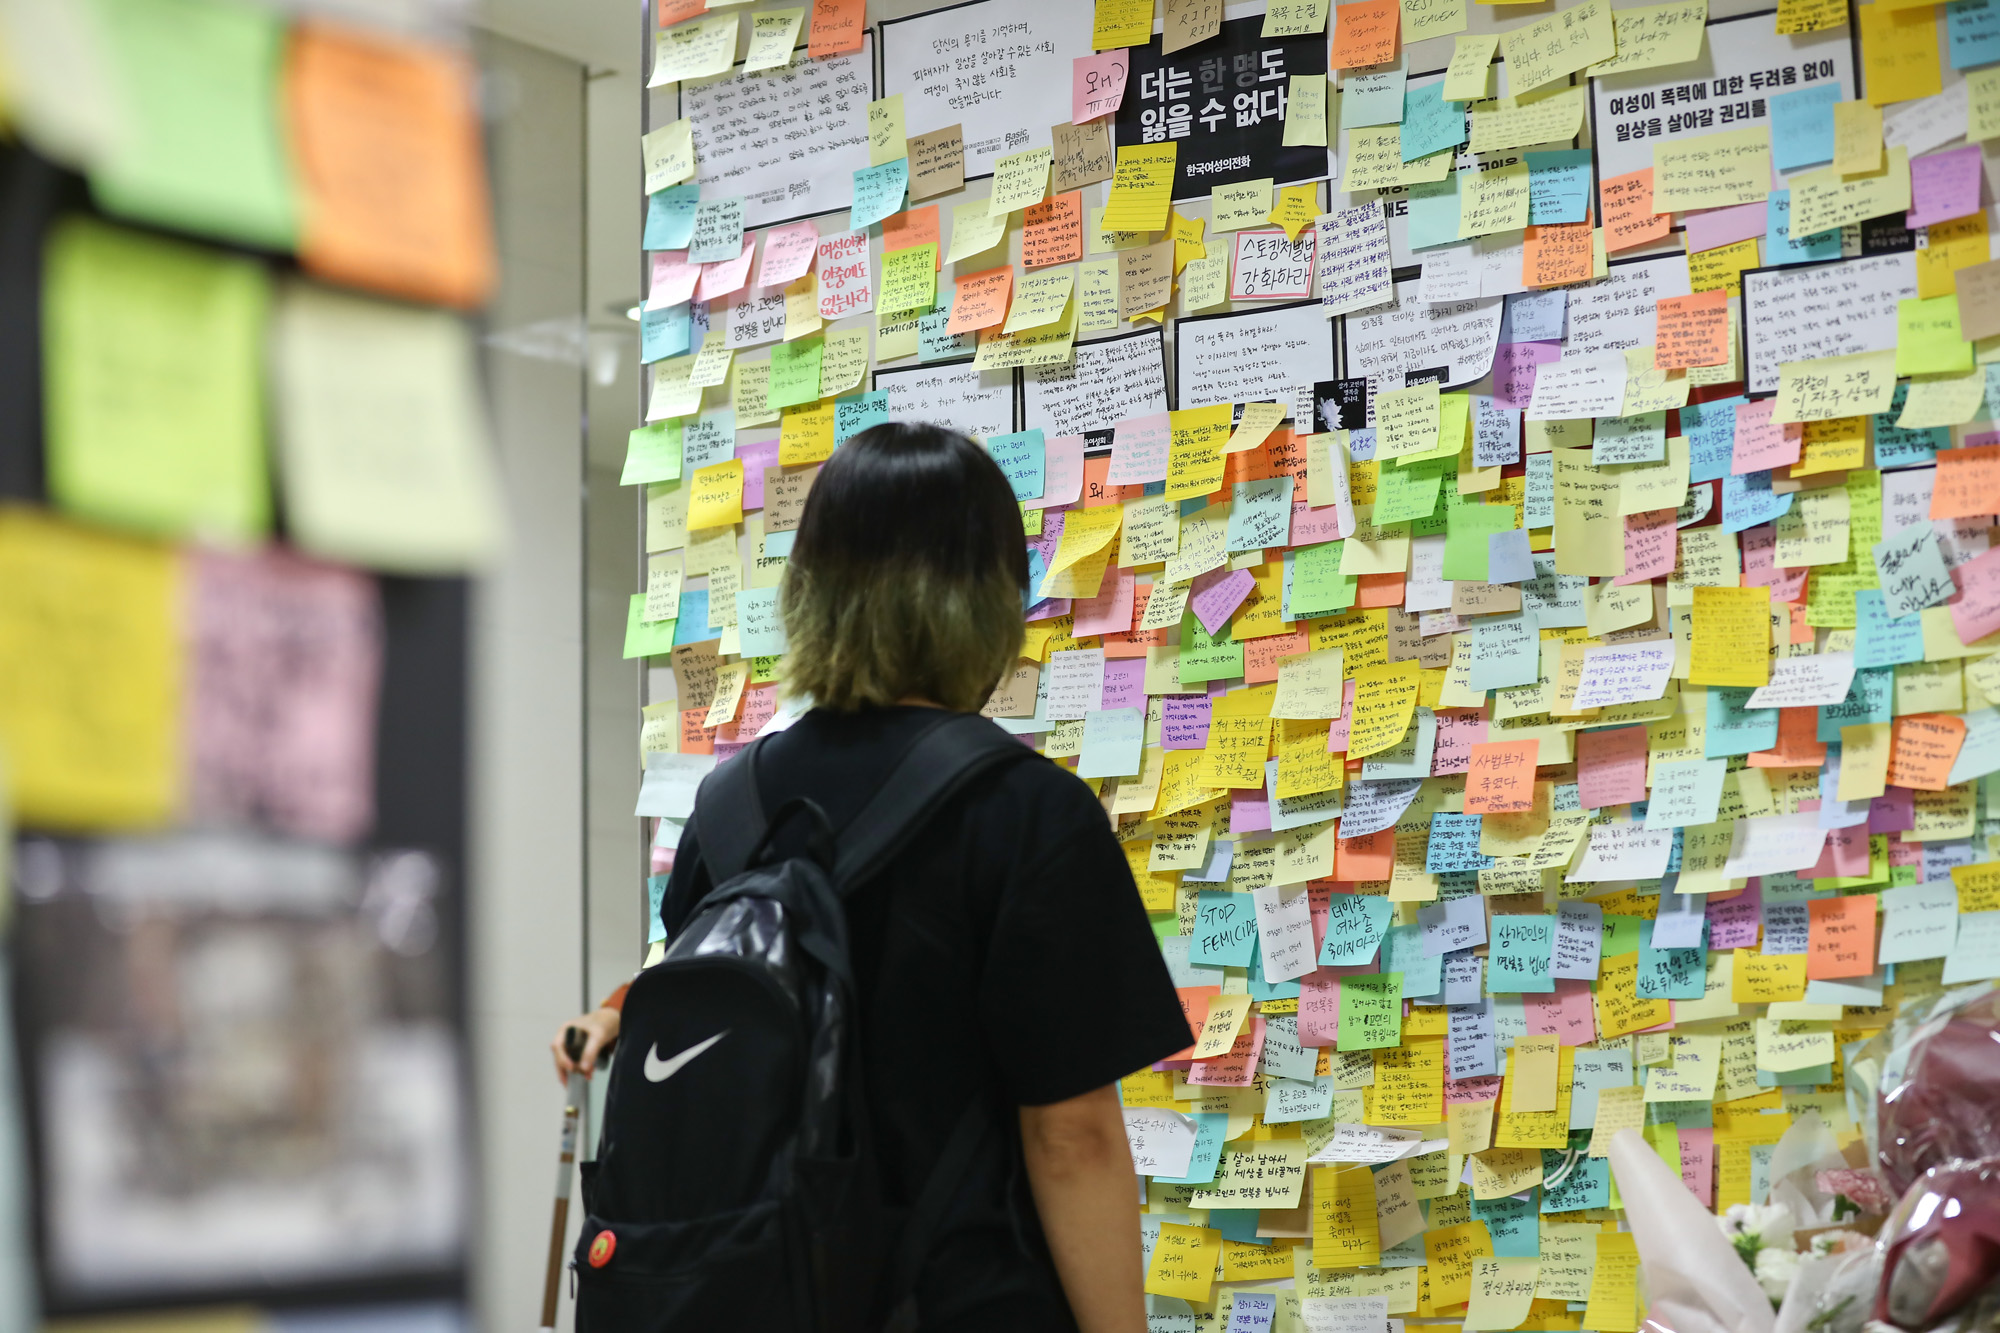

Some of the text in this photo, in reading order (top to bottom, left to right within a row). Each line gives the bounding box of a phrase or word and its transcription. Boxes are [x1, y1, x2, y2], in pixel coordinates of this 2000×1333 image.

[817, 1, 839, 17] Stop
[755, 18, 774, 28] STOP
[812, 19, 853, 34] Femicide
[933, 22, 1032, 54] 당신의 용기를 기억하며,
[913, 63, 950, 81] 피해자가
[955, 57, 976, 69] 일상을
[1140, 48, 1286, 102] 더는 한 명도
[924, 84, 948, 97] 여성이
[955, 78, 969, 89] 죽지
[1610, 59, 1835, 115] 여성이 폭력에 대한 두려움 없이
[1140, 103, 1193, 143] 잃을
[1200, 98, 1226, 133] 수
[1234, 86, 1287, 125] 없다
[1615, 100, 1766, 142] 일상을 살아갈 권리를
[1005, 128, 1027, 143] Basic
[1186, 155, 1251, 176] 한국여성의전화
[789, 179, 809, 192] Basic
[819, 233, 867, 259] 여성안전
[1241, 238, 1316, 262] 스토킹처벌법
[822, 263, 868, 287] 안중에도
[1242, 268, 1310, 295] 강화하라
[892, 309, 914, 320] STOP
[880, 320, 919, 336] FEMICIDE
[1475, 752, 1525, 769] 사법부가
[1481, 777, 1520, 790] 죽였다.
[1200, 903, 1236, 924] STOP
[1331, 897, 1366, 919] 더이상
[1335, 914, 1372, 936] 여자 좀
[1234, 1168, 1263, 1180] 세상을
[1214, 1188, 1236, 1197] 고인의
[1239, 1187, 1261, 1198] 명복을
[1265, 1186, 1289, 1197] 빕니다
